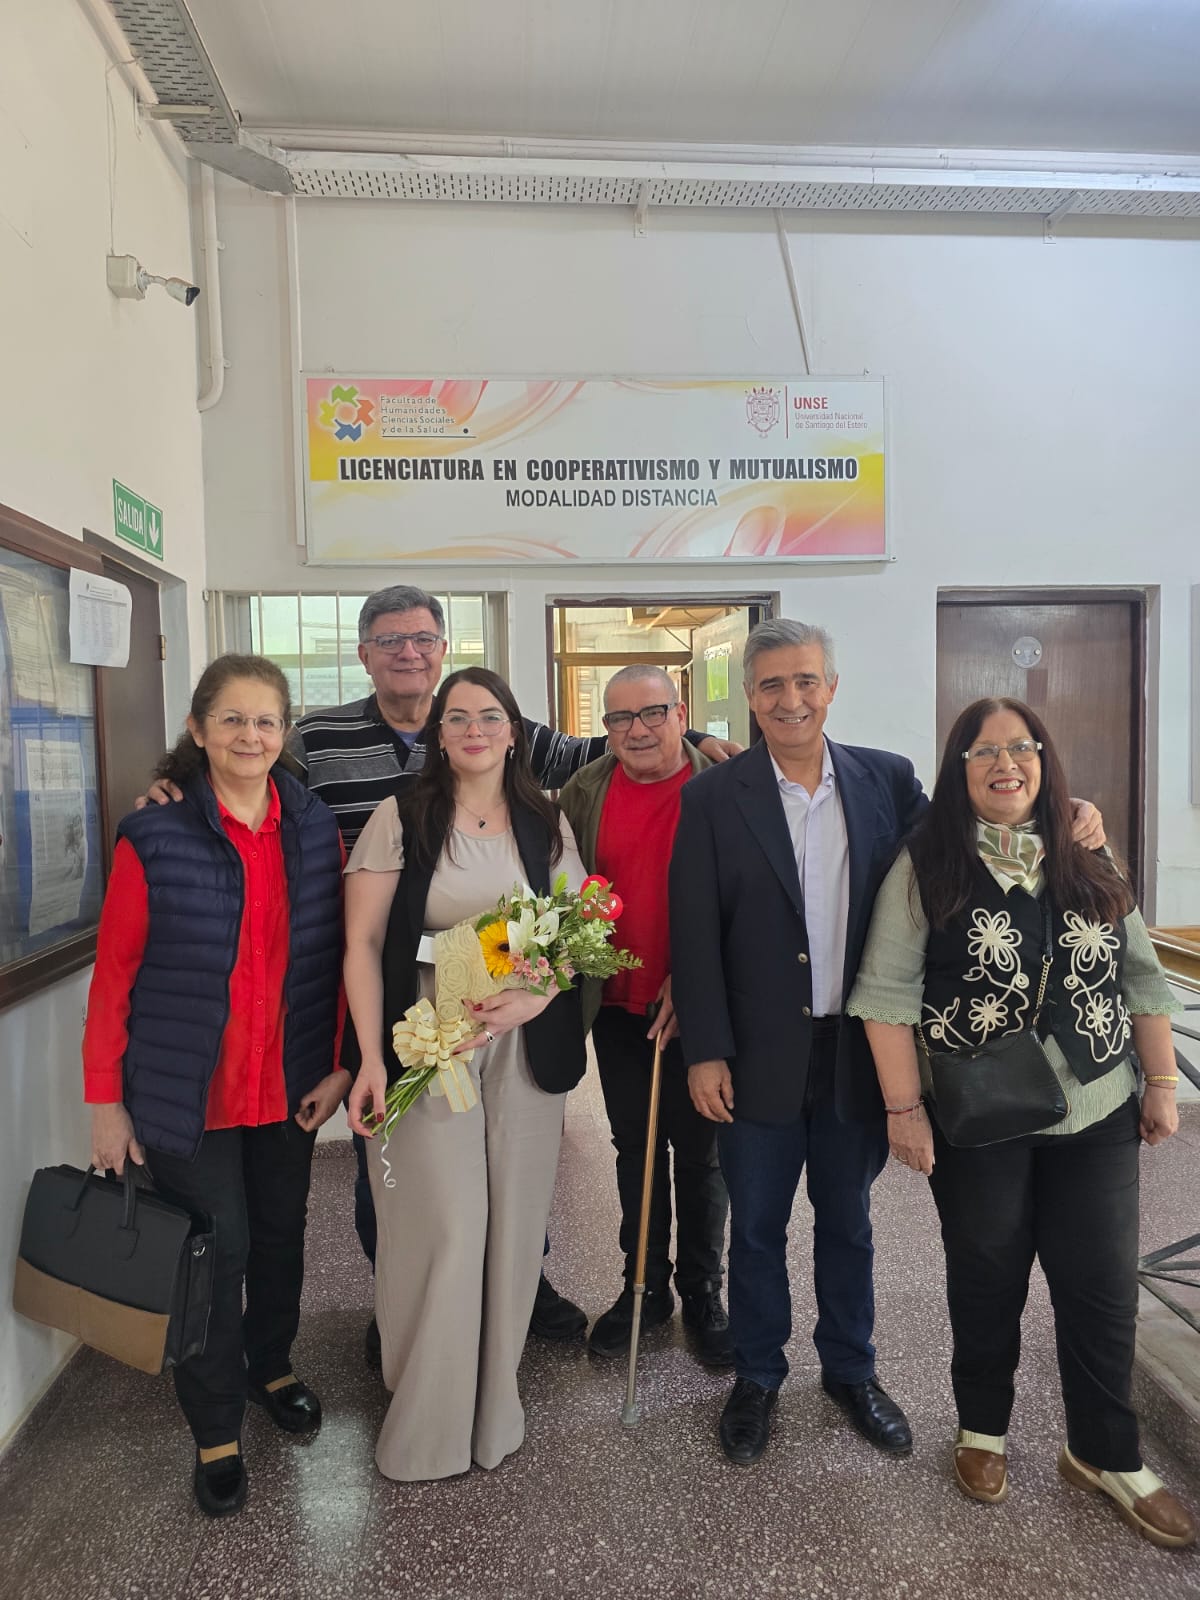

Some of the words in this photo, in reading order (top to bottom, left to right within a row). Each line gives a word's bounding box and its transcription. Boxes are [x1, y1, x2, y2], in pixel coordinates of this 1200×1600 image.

[381, 396, 423, 404] Facultad
[425, 396, 436, 404] de
[794, 397, 828, 409] UNSE
[381, 406, 446, 414] Humanidades
[381, 416, 418, 424] Ciencias
[419, 416, 455, 424] Sociales
[795, 412, 833, 420] Universidad
[834, 412, 864, 420] Nacional
[805, 421, 833, 430] Santiago
[835, 421, 846, 429] del
[382, 427, 387, 435] y
[340, 458, 484, 481] LICENCIATURA
[494, 459, 517, 481] EN
[527, 459, 700, 481] COOPERATIVISMO
[709, 459, 721, 480] Y
[730, 458, 858, 480] MUTUALISMO
[506, 489, 616, 507] MODALIDAD
[622, 489, 718, 507] DISTANCIA
[117, 497, 144, 536] SALIDA
